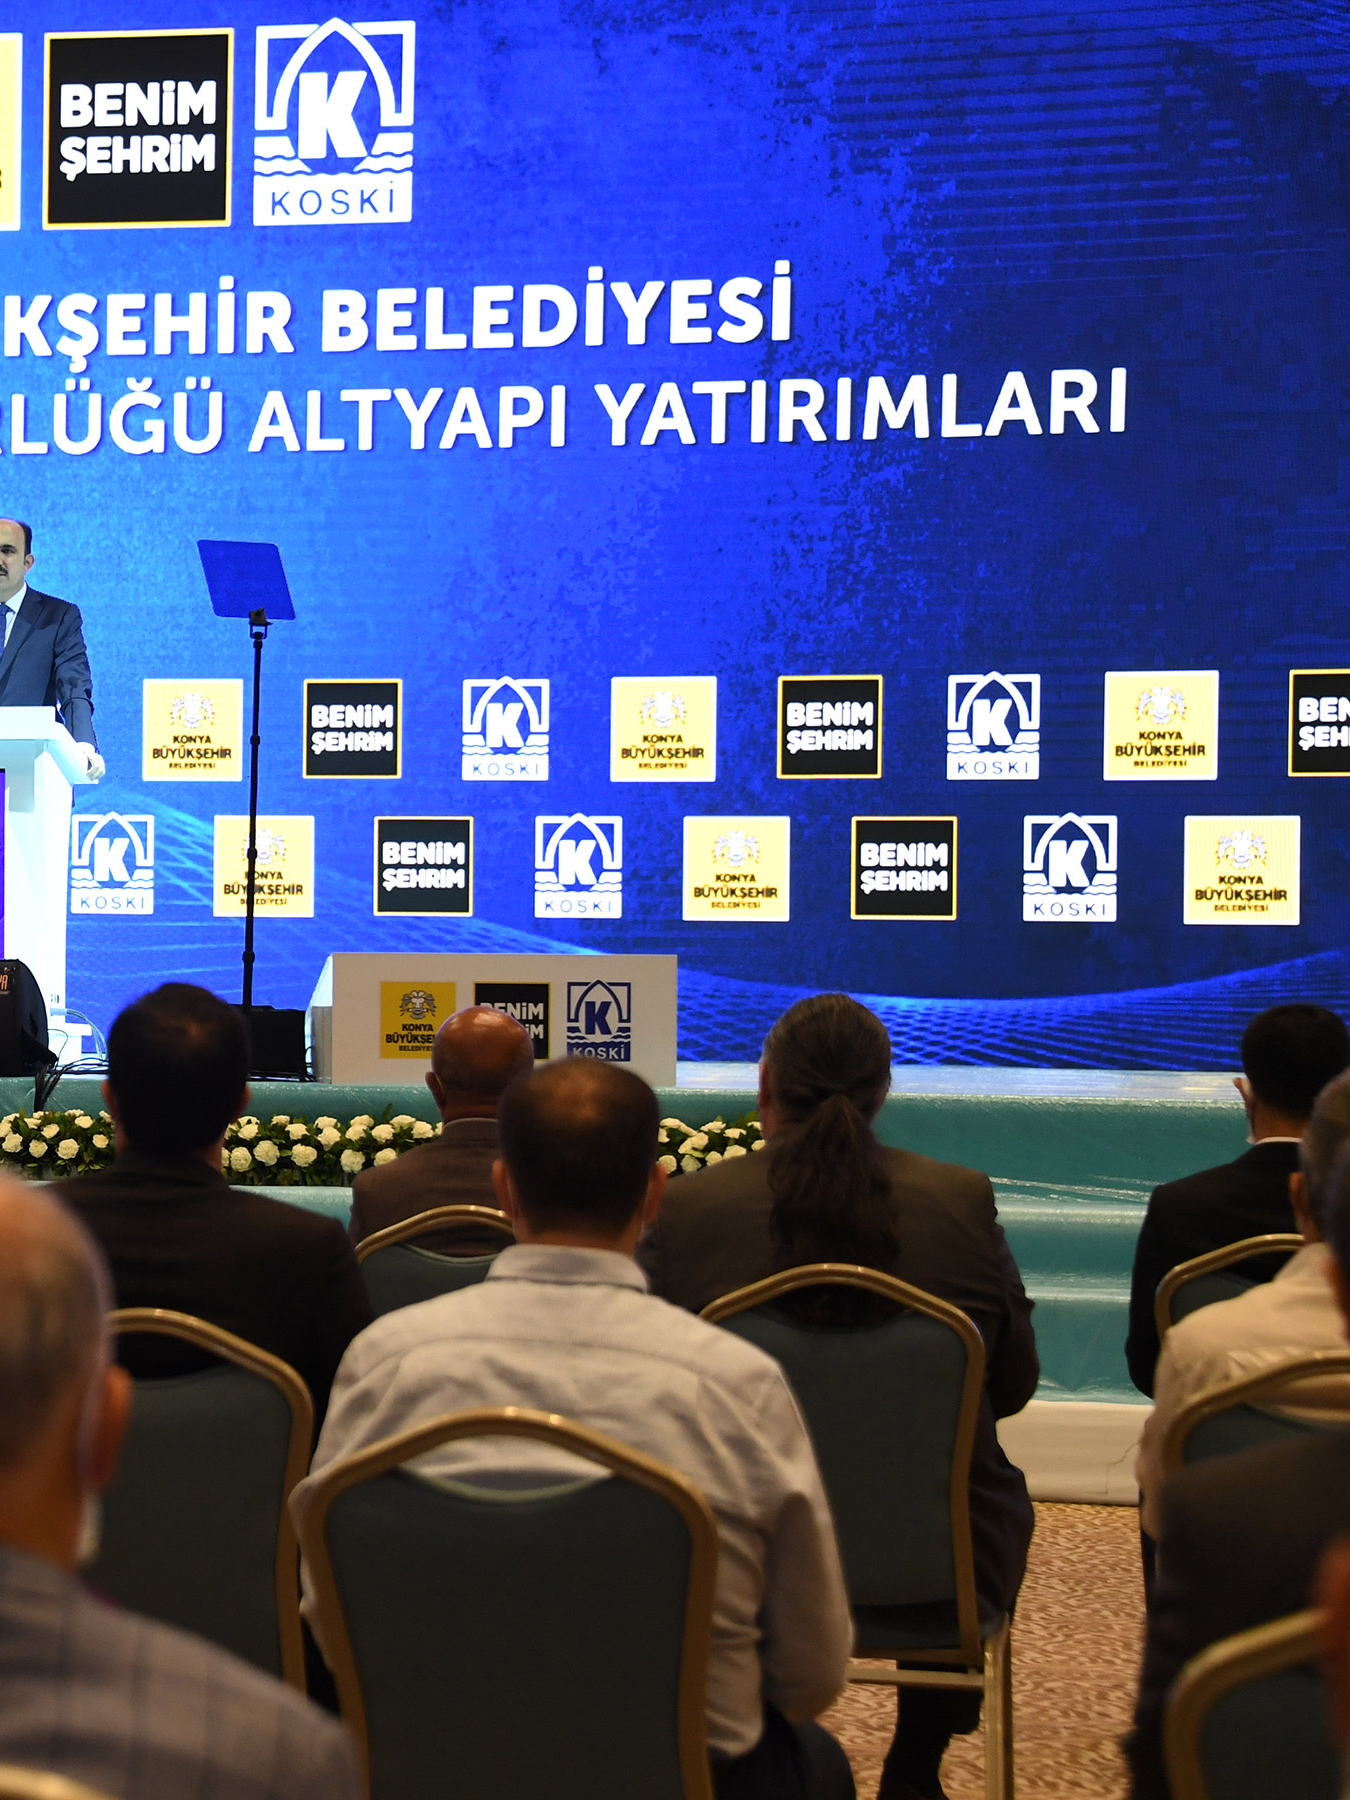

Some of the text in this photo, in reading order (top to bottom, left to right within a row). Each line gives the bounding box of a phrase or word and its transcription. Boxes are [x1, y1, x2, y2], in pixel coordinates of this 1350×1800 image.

[61, 81, 216, 127] BENİM
[60, 134, 215, 181] ŞEHRİM
[272, 180, 393, 224] KOSKİ
[322, 260, 791, 352] BELEDİYESİ
[248, 385, 565, 451] ALTYAPI
[595, 368, 1126, 445] YATIRIMLARI
[1299, 697, 1350, 722] BEN
[173, 735, 211, 744] KONYA
[643, 735, 682, 743] KONYA
[1139, 731, 1182, 741] KONYA
[1299, 726, 1350, 750] ŞEH
[716, 874, 756, 883] KONYA
[1219, 876, 1263, 885] KONYA
[224, 881, 303, 895] BÜYKŞEHİR
[402, 1023, 434, 1031] KONYA
[386, 1032, 435, 1044] BÜYÜKŞE
